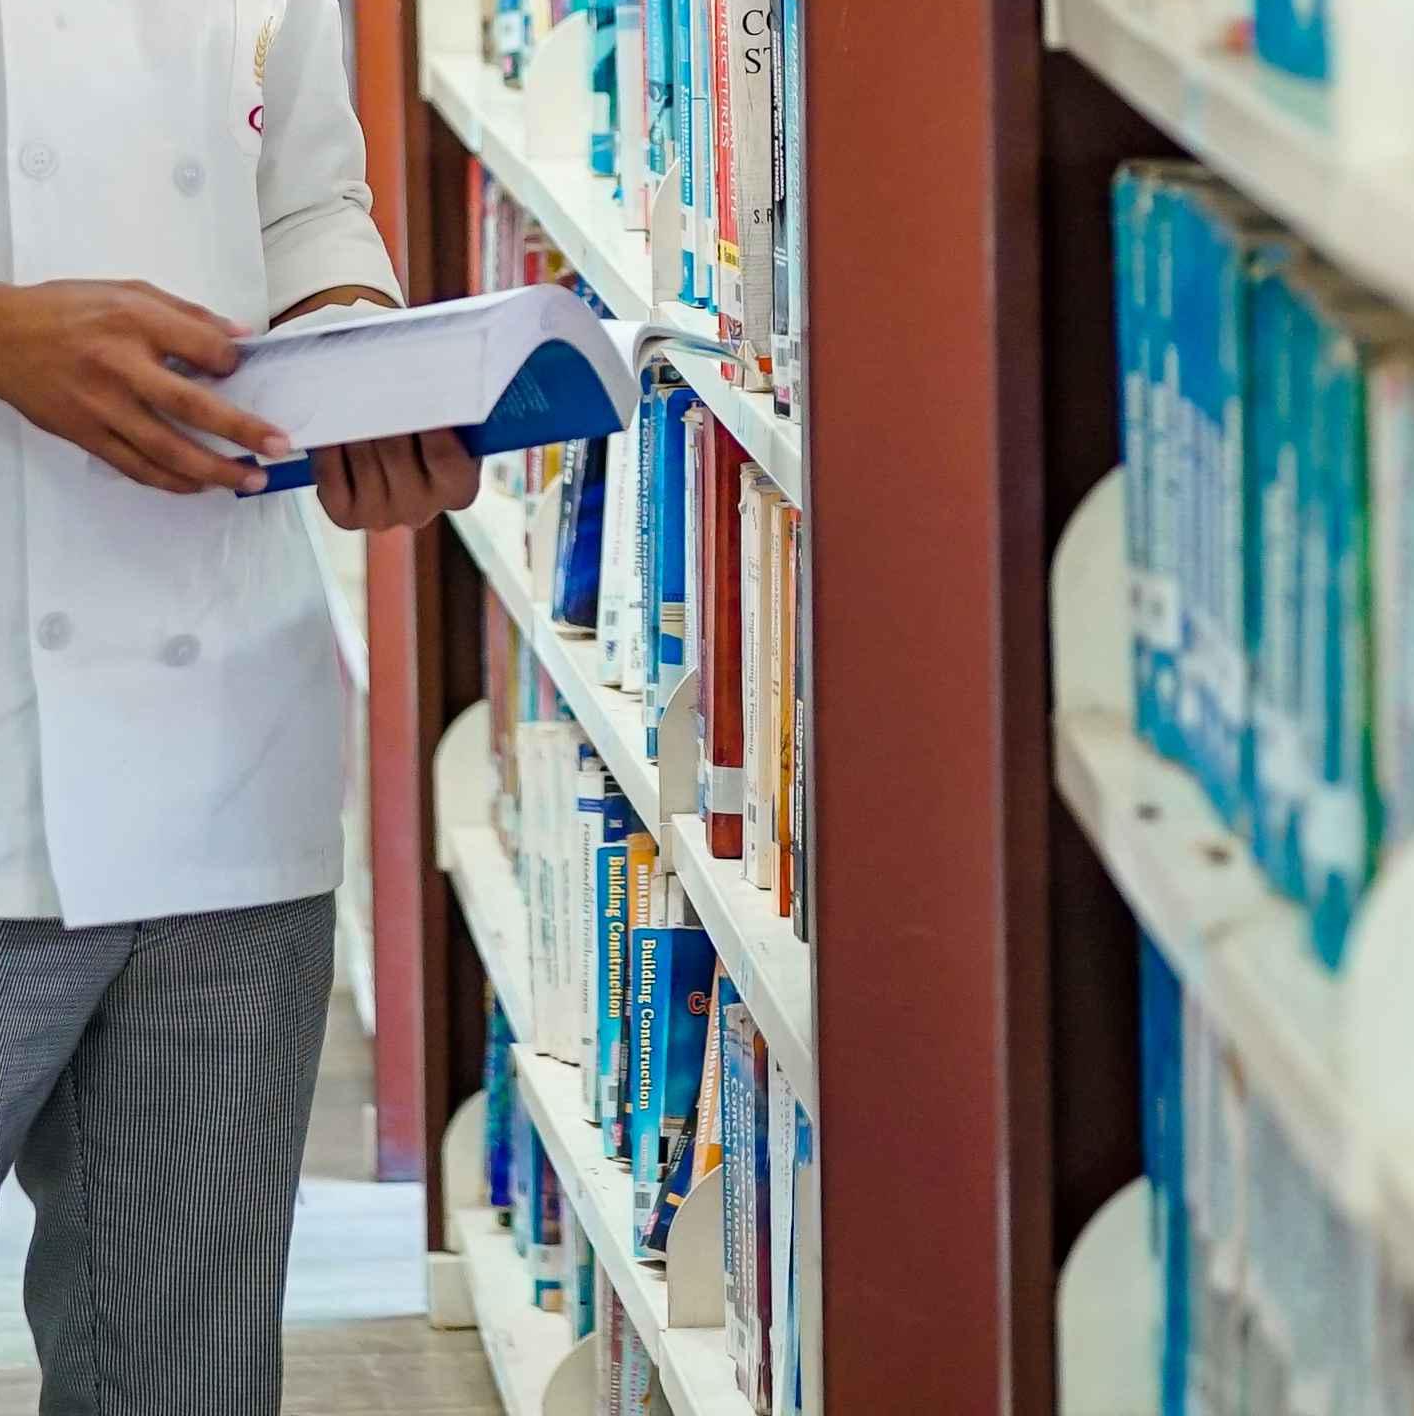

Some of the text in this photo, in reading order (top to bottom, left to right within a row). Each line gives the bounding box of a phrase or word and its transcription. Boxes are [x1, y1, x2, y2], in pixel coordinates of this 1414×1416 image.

[641, 417, 650, 529] FOUNDATION
[604, 855, 626, 918] Building
[637, 864, 649, 928] BUILDIN
[608, 922, 626, 1018] Construction
[637, 938, 657, 1111] Building Construction
[722, 1030, 733, 1273] FOUNDATION ENGINEERING
